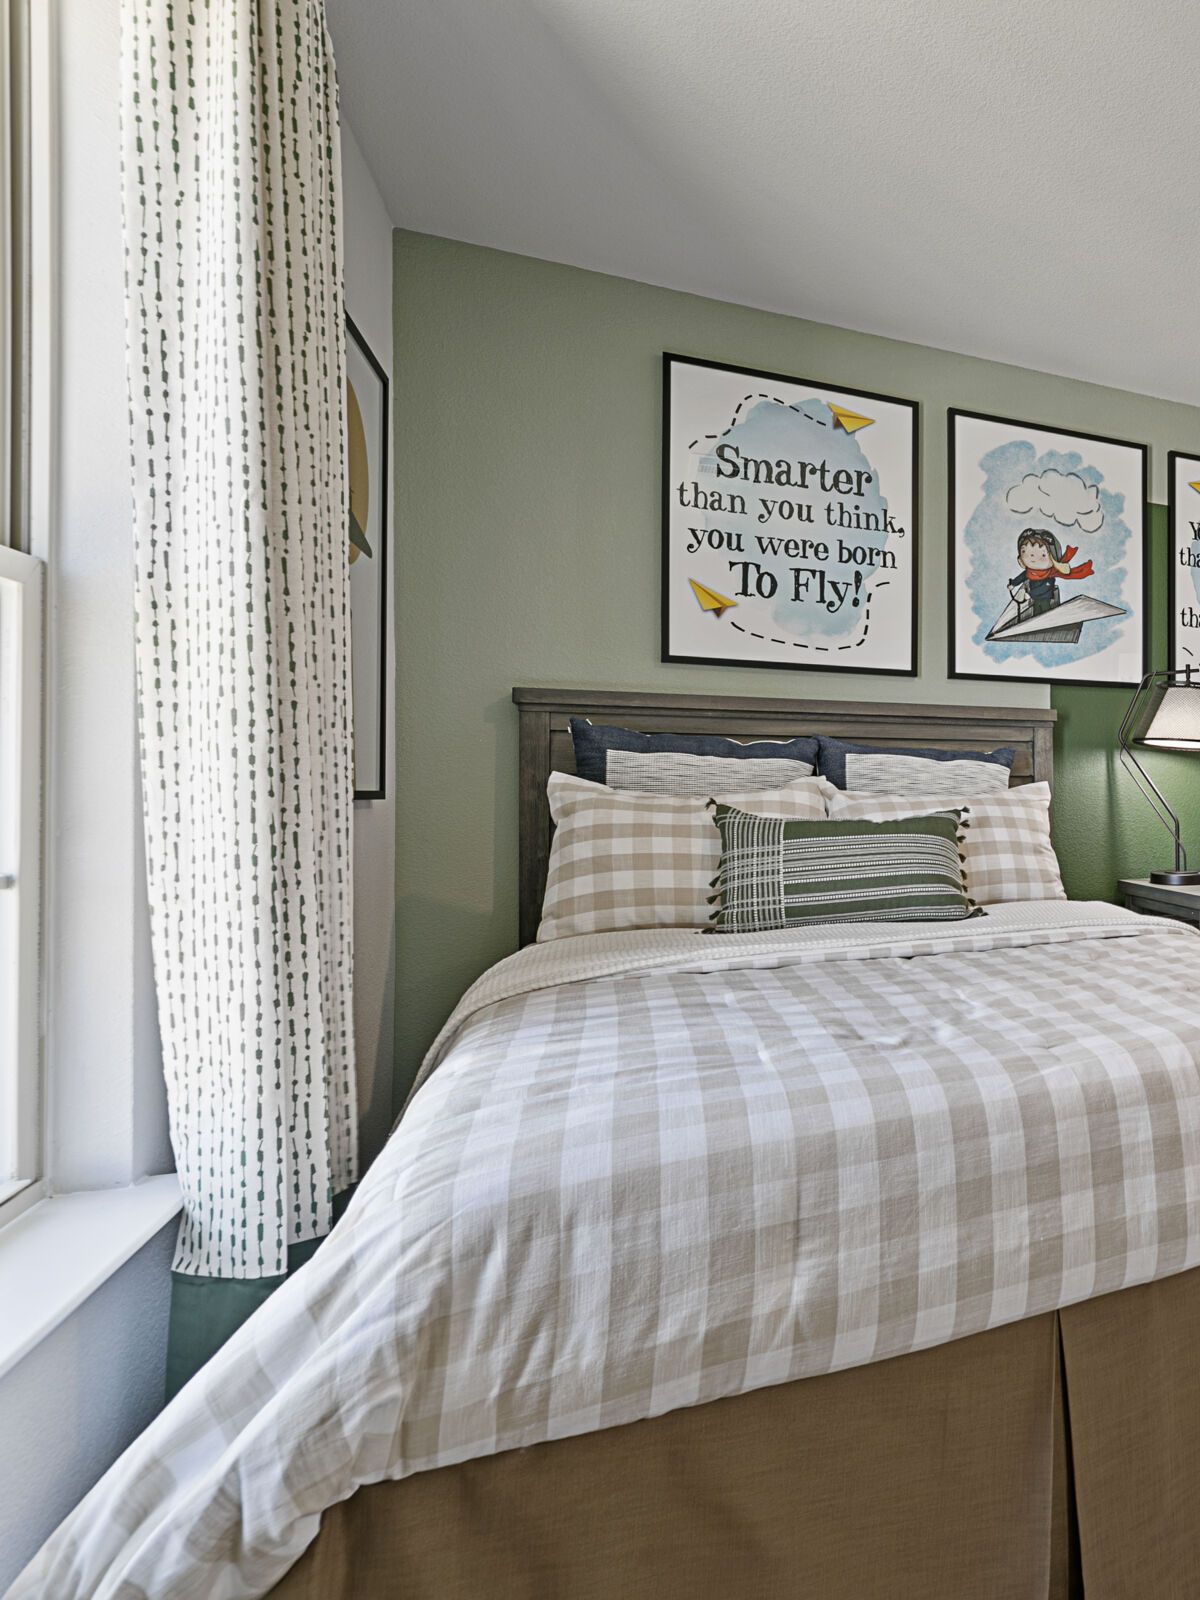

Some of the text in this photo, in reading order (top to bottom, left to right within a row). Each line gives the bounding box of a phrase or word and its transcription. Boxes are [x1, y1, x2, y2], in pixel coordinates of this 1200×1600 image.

[716, 443, 872, 497] Smarter
[676, 481, 905, 537] than you think,
[687, 527, 898, 569] you were born
[729, 561, 863, 613] To Fly!
